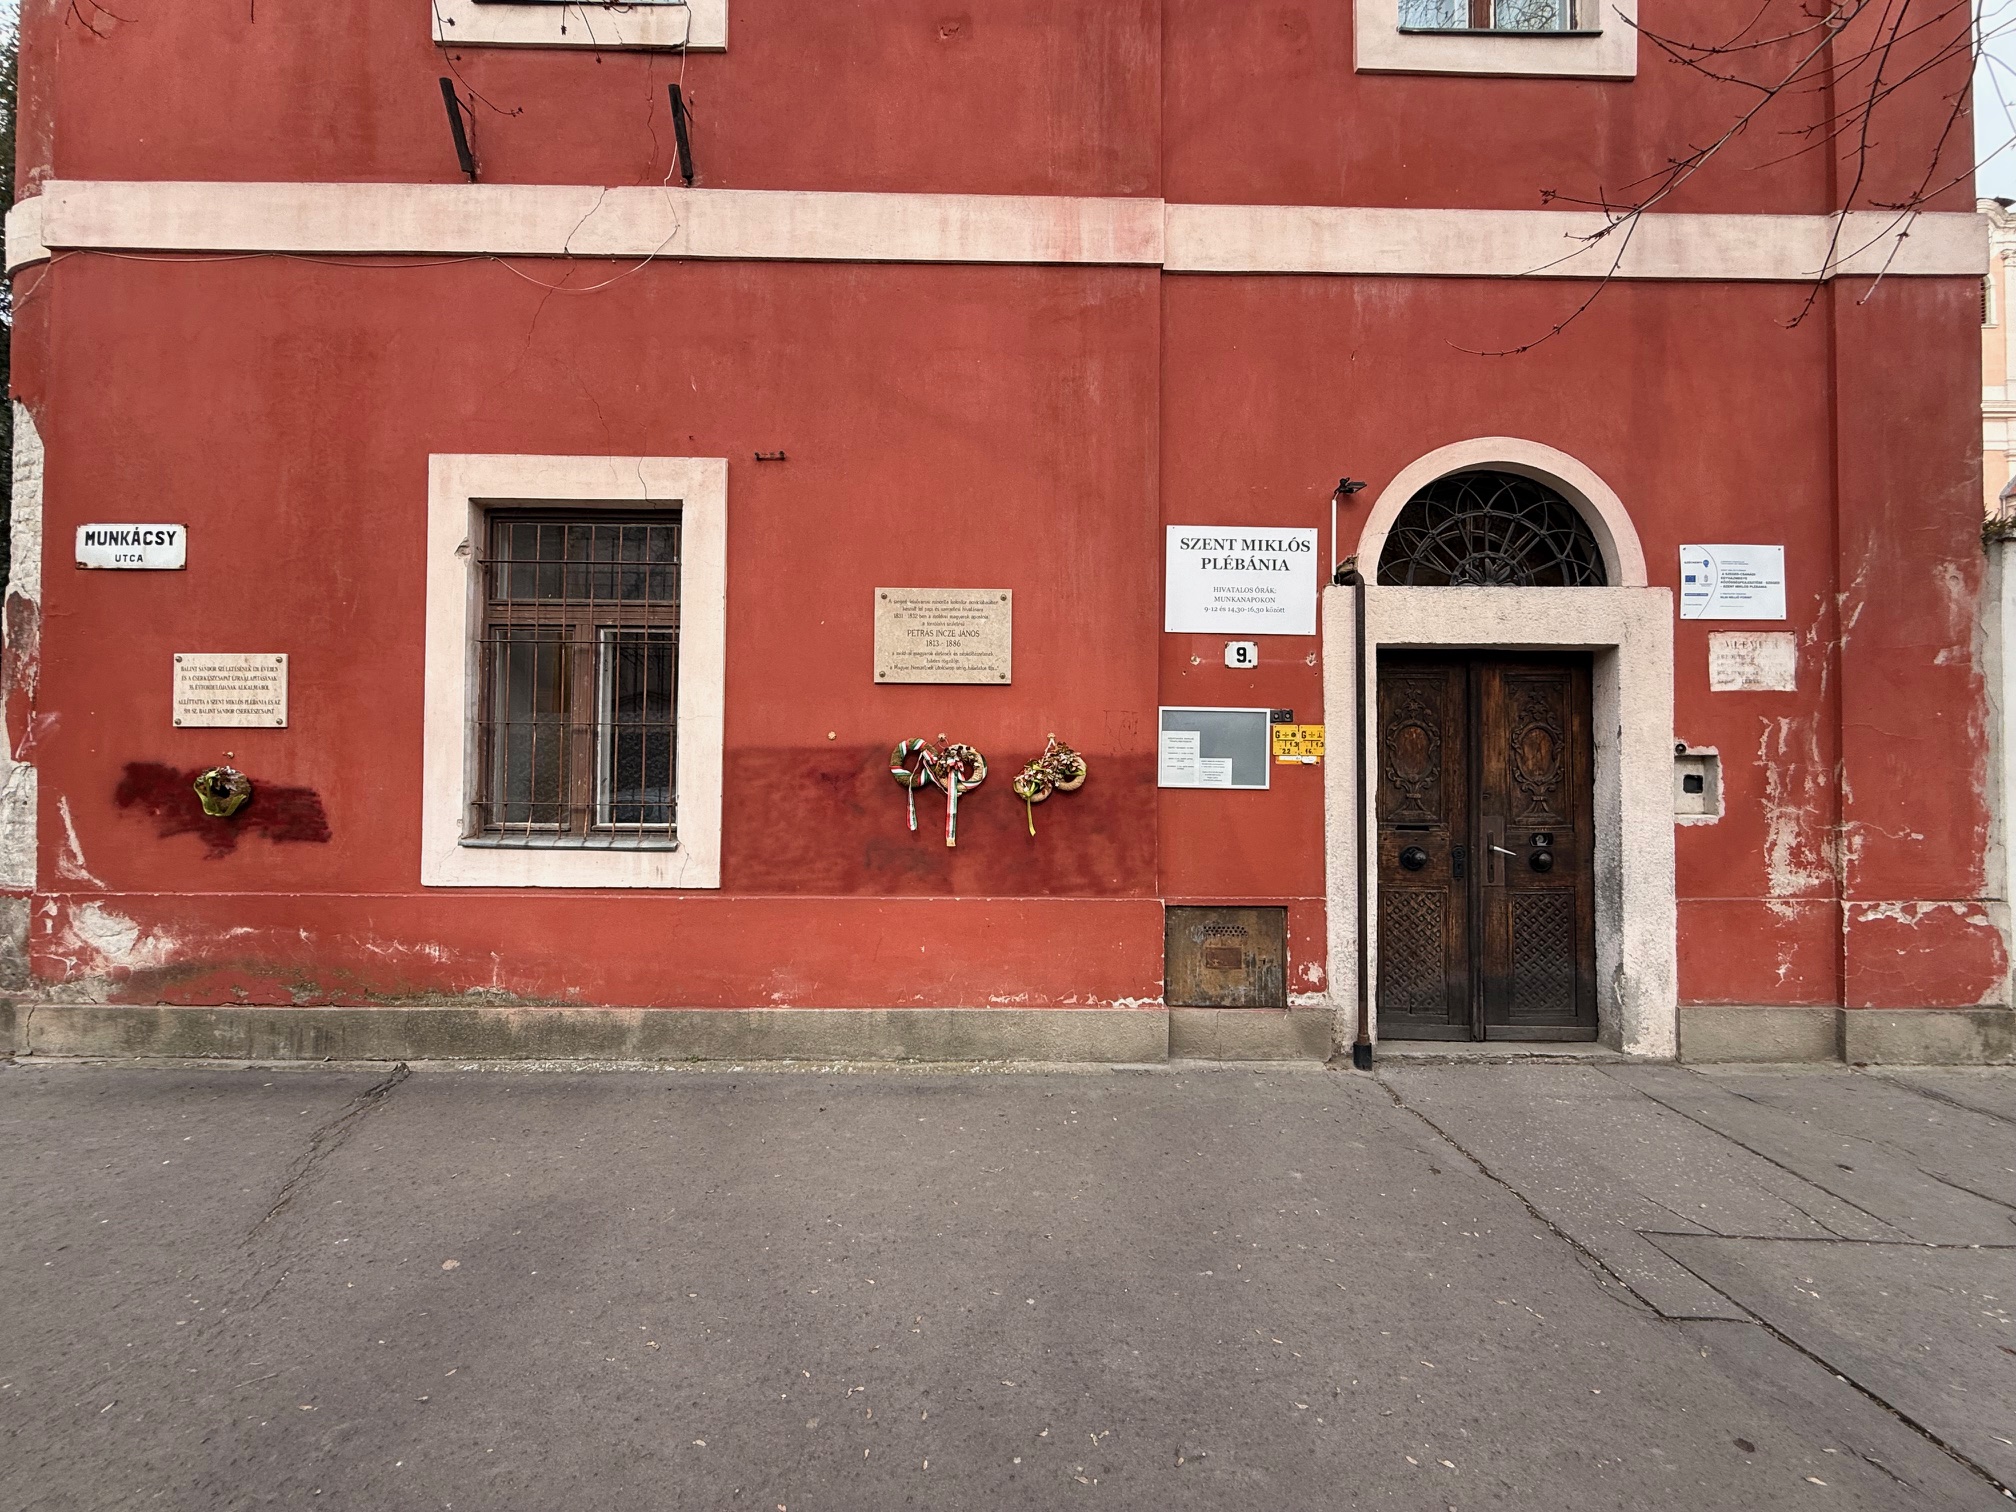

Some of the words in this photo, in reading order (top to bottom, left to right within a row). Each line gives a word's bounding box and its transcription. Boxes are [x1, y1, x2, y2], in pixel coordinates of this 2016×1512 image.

[85, 527, 177, 546] MUNKÁCSY
[1180, 537, 1237, 550] SZENT
[1241, 537, 1311, 552] MIKLÓS
[114, 554, 144, 563] UTCA
[1201, 555, 1290, 571] PLÉBÁNIA
[1213, 586, 1254, 594] HIVATALOS
[1254, 586, 1277, 594] ÓRÁK:
[1214, 596, 1276, 604] MUNKANAPOKON
[1266, 606, 1286, 614] között
[958, 628, 980, 638] JÁNOS
[1236, 647, 1252, 663] 9.
[1275, 730, 1281, 739] G
[1301, 730, 1307, 739] G
